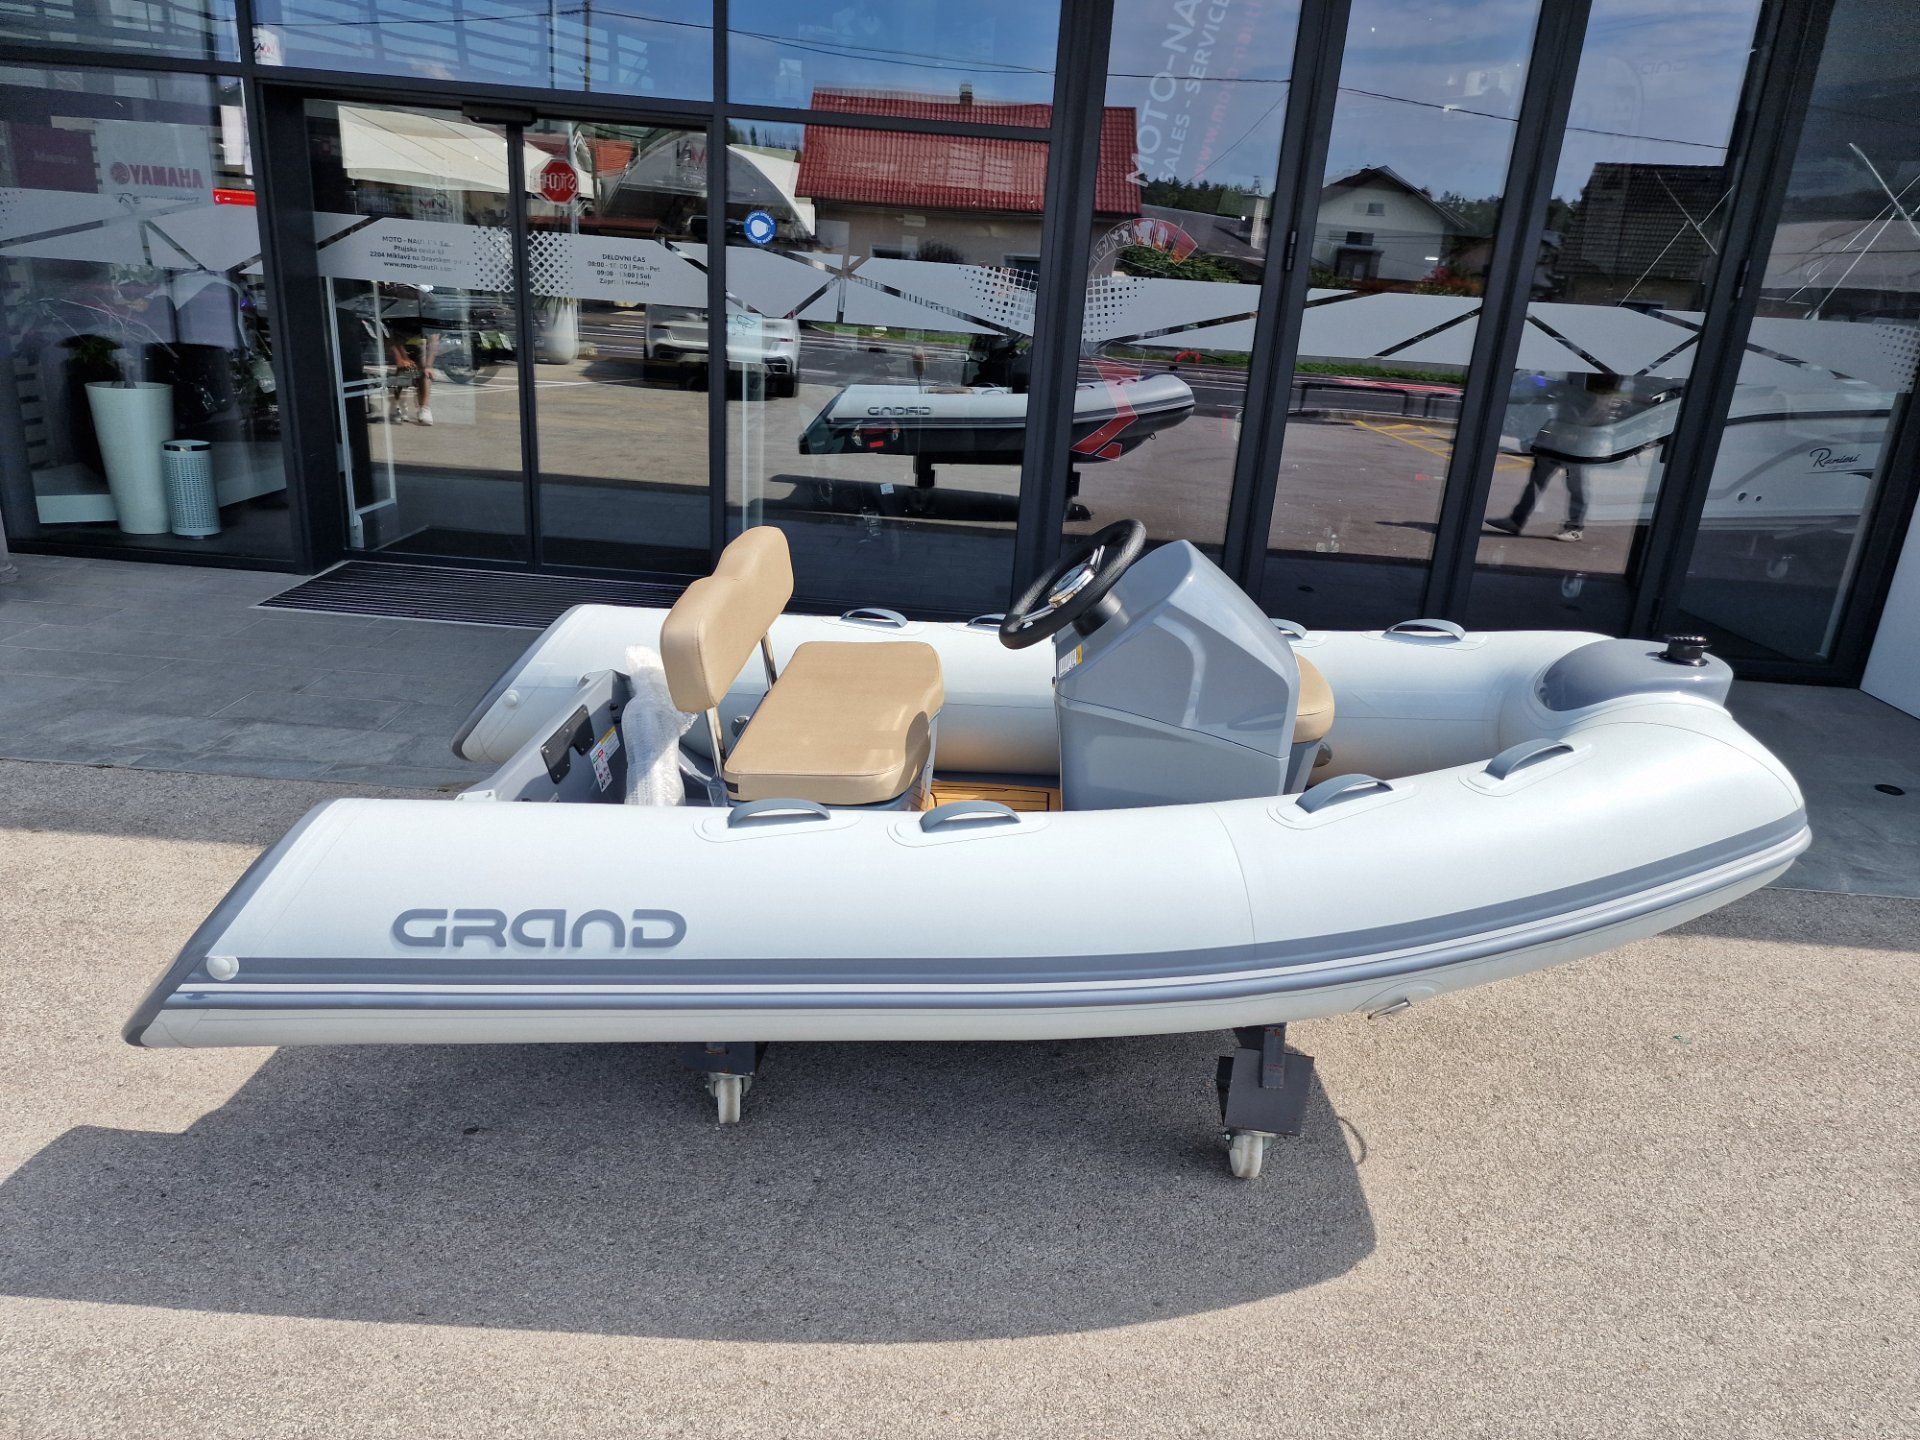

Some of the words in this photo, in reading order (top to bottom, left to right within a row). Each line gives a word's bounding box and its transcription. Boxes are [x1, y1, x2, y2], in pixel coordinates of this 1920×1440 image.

[1157, 112, 1191, 185] SALES
[128, 164, 204, 189] YAMAHA
[382, 235, 402, 244] MOTO
[602, 253, 632, 262] DELOVNI
[632, 254, 646, 263] ČAS
[392, 907, 688, 949] GRAND
